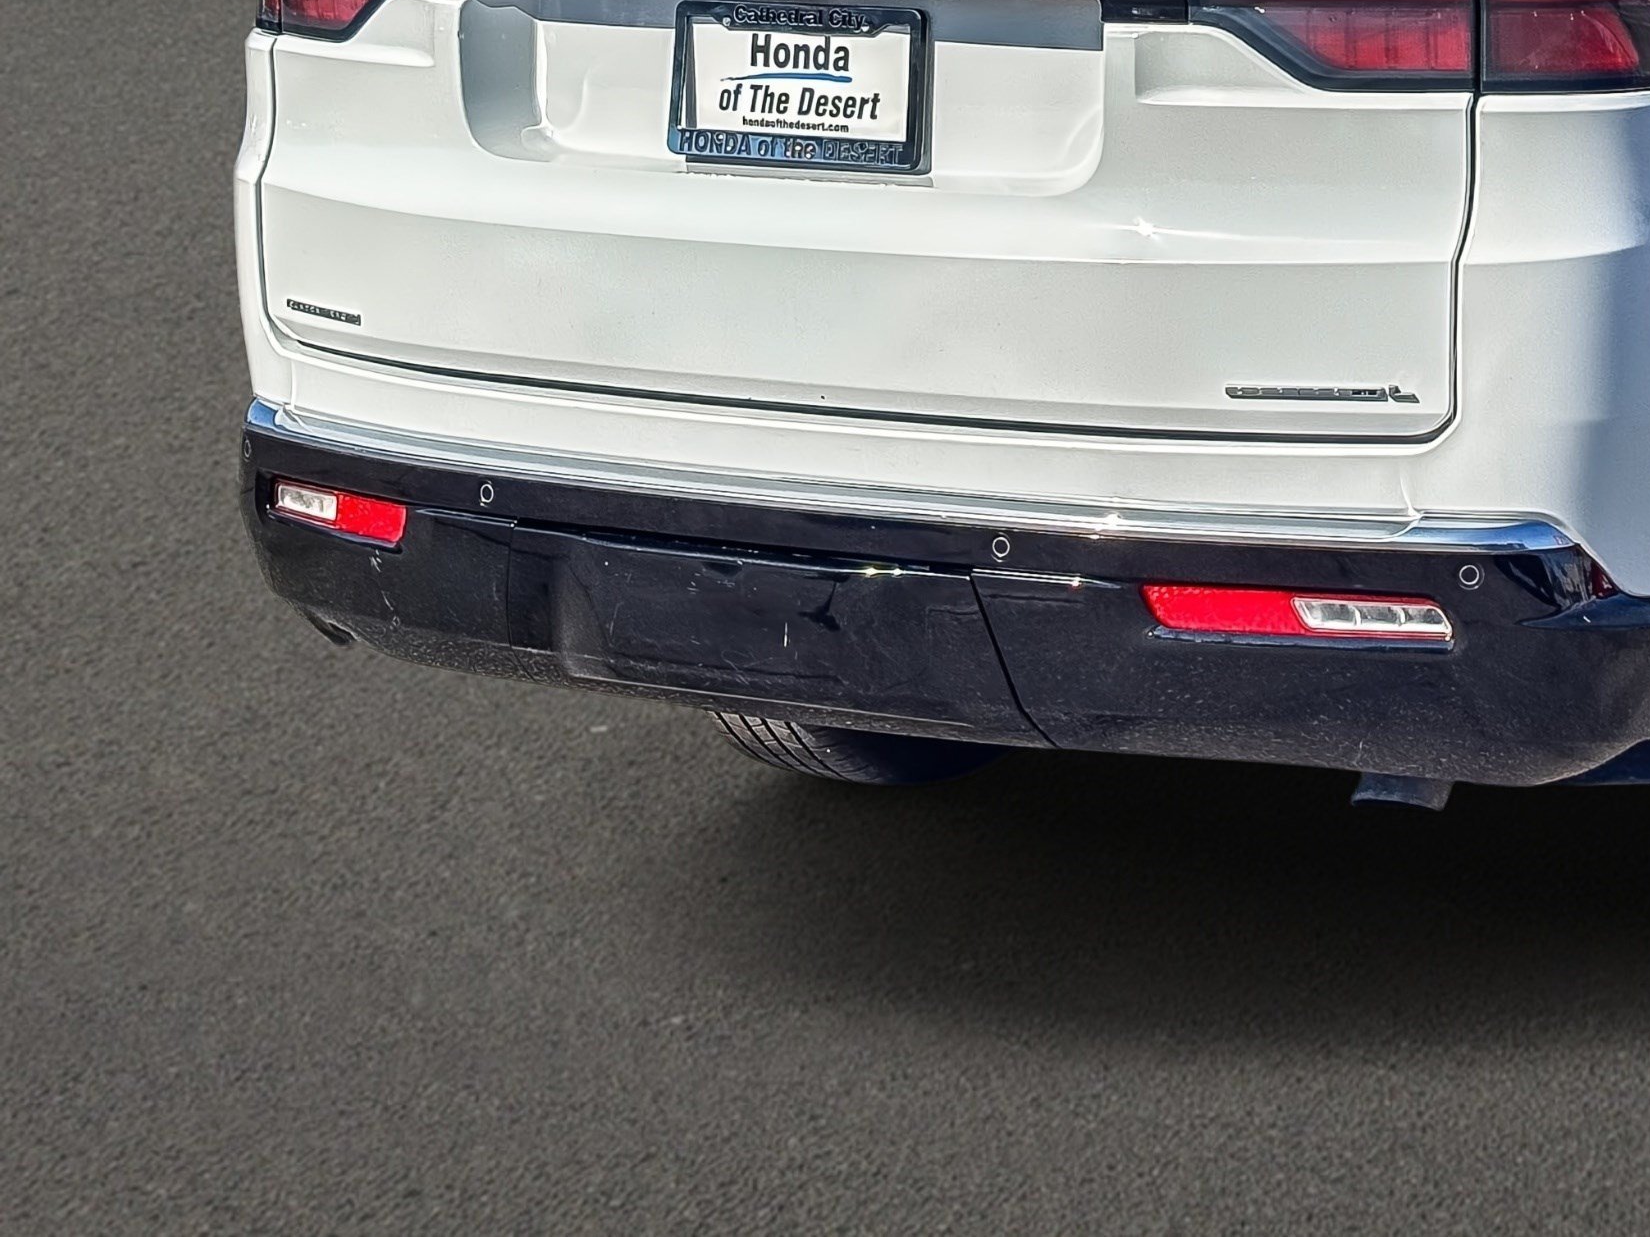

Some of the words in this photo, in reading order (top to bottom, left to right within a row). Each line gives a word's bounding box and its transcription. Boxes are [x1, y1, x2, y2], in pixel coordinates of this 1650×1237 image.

[733, 4, 824, 27] Cathedral
[828, 8, 868, 33] City
[749, 33, 850, 73] Honda
[718, 84, 743, 112] of
[750, 84, 790, 115] The
[796, 87, 881, 121] Desert
[678, 129, 752, 156] HONDA
[757, 137, 779, 158] of
[821, 142, 905, 167] DESERT
